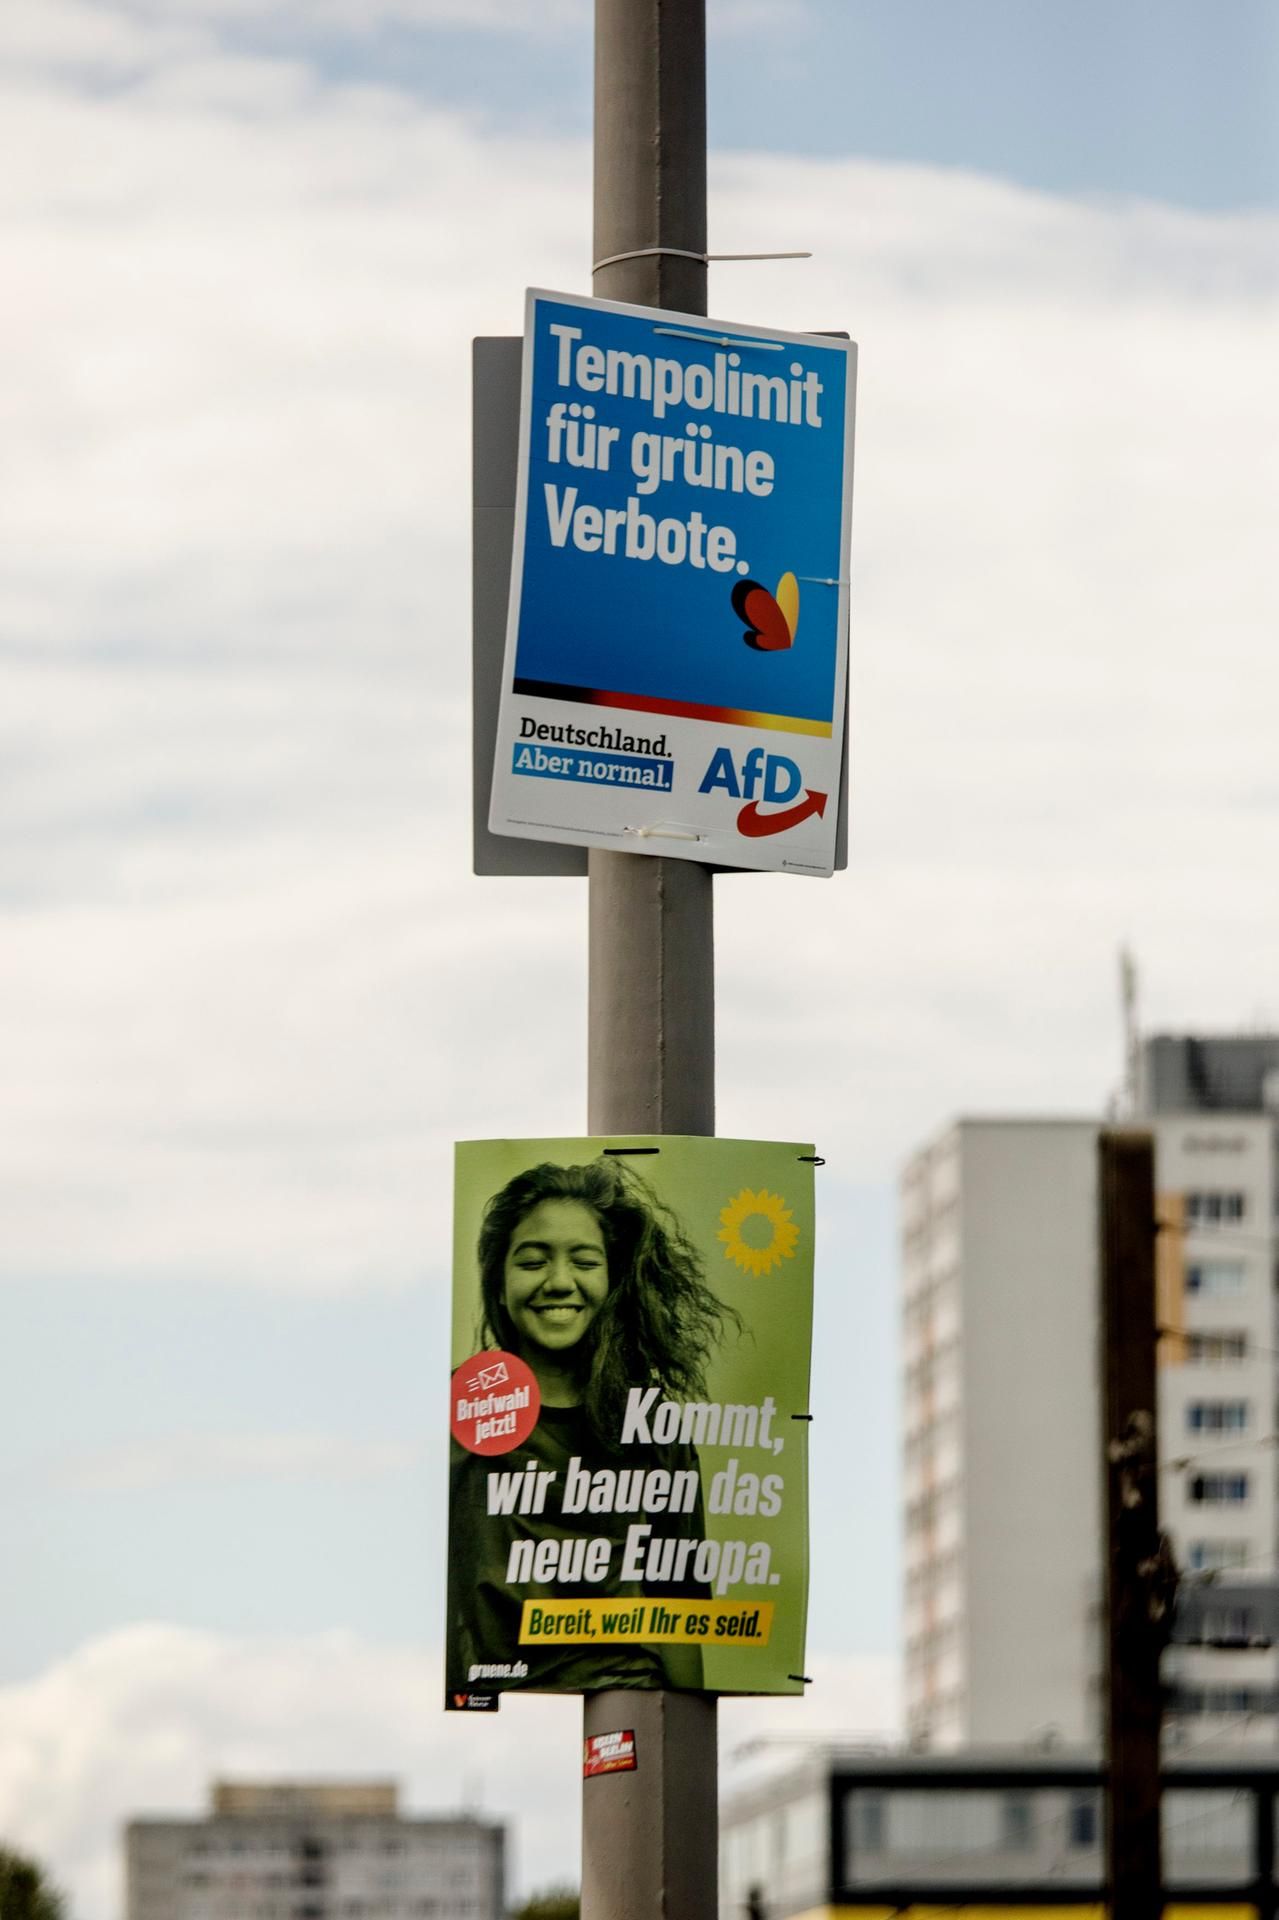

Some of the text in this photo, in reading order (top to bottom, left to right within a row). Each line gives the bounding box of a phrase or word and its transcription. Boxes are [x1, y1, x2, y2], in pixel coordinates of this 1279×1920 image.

[549, 323, 823, 428] Tempolimit
[545, 403, 775, 497] für grüne
[543, 483, 750, 576] Verbote.
[519, 717, 673, 758] Deutschland.
[515, 747, 671, 789] Aber normal.
[698, 747, 802, 804] AfD
[456, 1385, 530, 1421] Briefwahl
[475, 1411, 516, 1445] jetzt!
[620, 1387, 785, 1456] Kommt,
[487, 1456, 785, 1517] wir bauen das
[505, 1524, 781, 1596] neue Europa.
[528, 1605, 763, 1638] Bereit, weil Ihr es seid.
[467, 1660, 529, 1682] gruene.de
